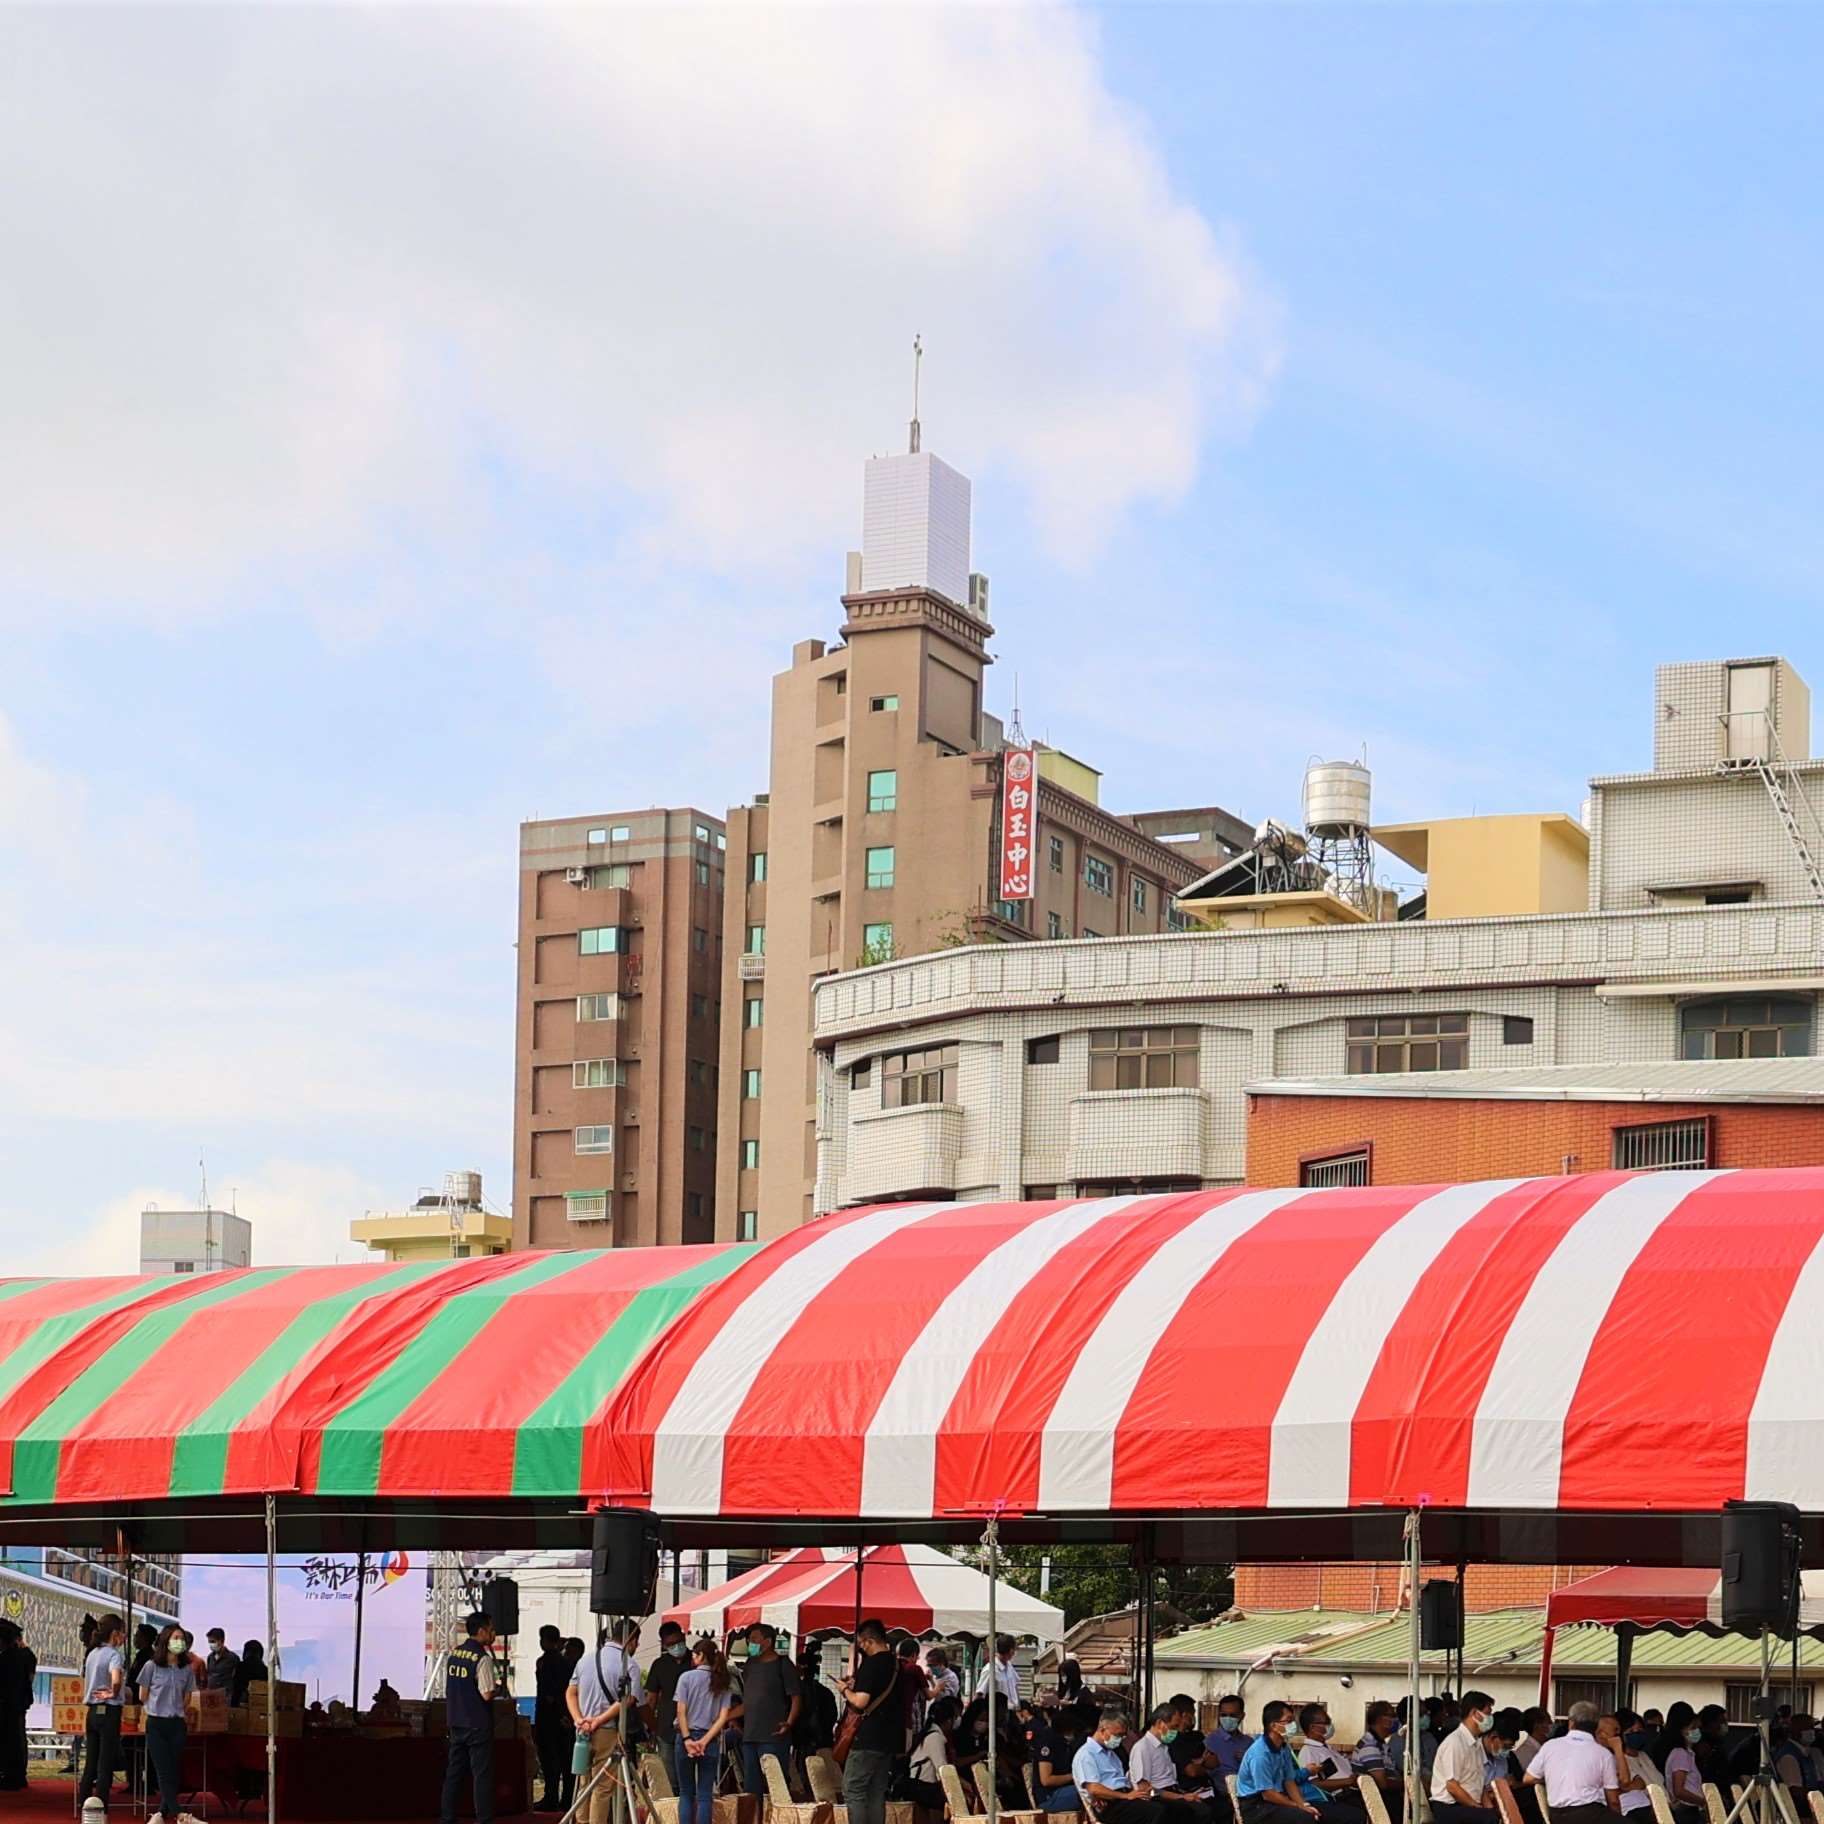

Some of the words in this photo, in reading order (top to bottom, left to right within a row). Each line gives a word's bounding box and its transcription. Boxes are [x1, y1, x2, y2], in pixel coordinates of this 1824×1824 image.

[1005, 785, 1029, 893] 白玉中心
[449, 1664, 468, 1679] CID
